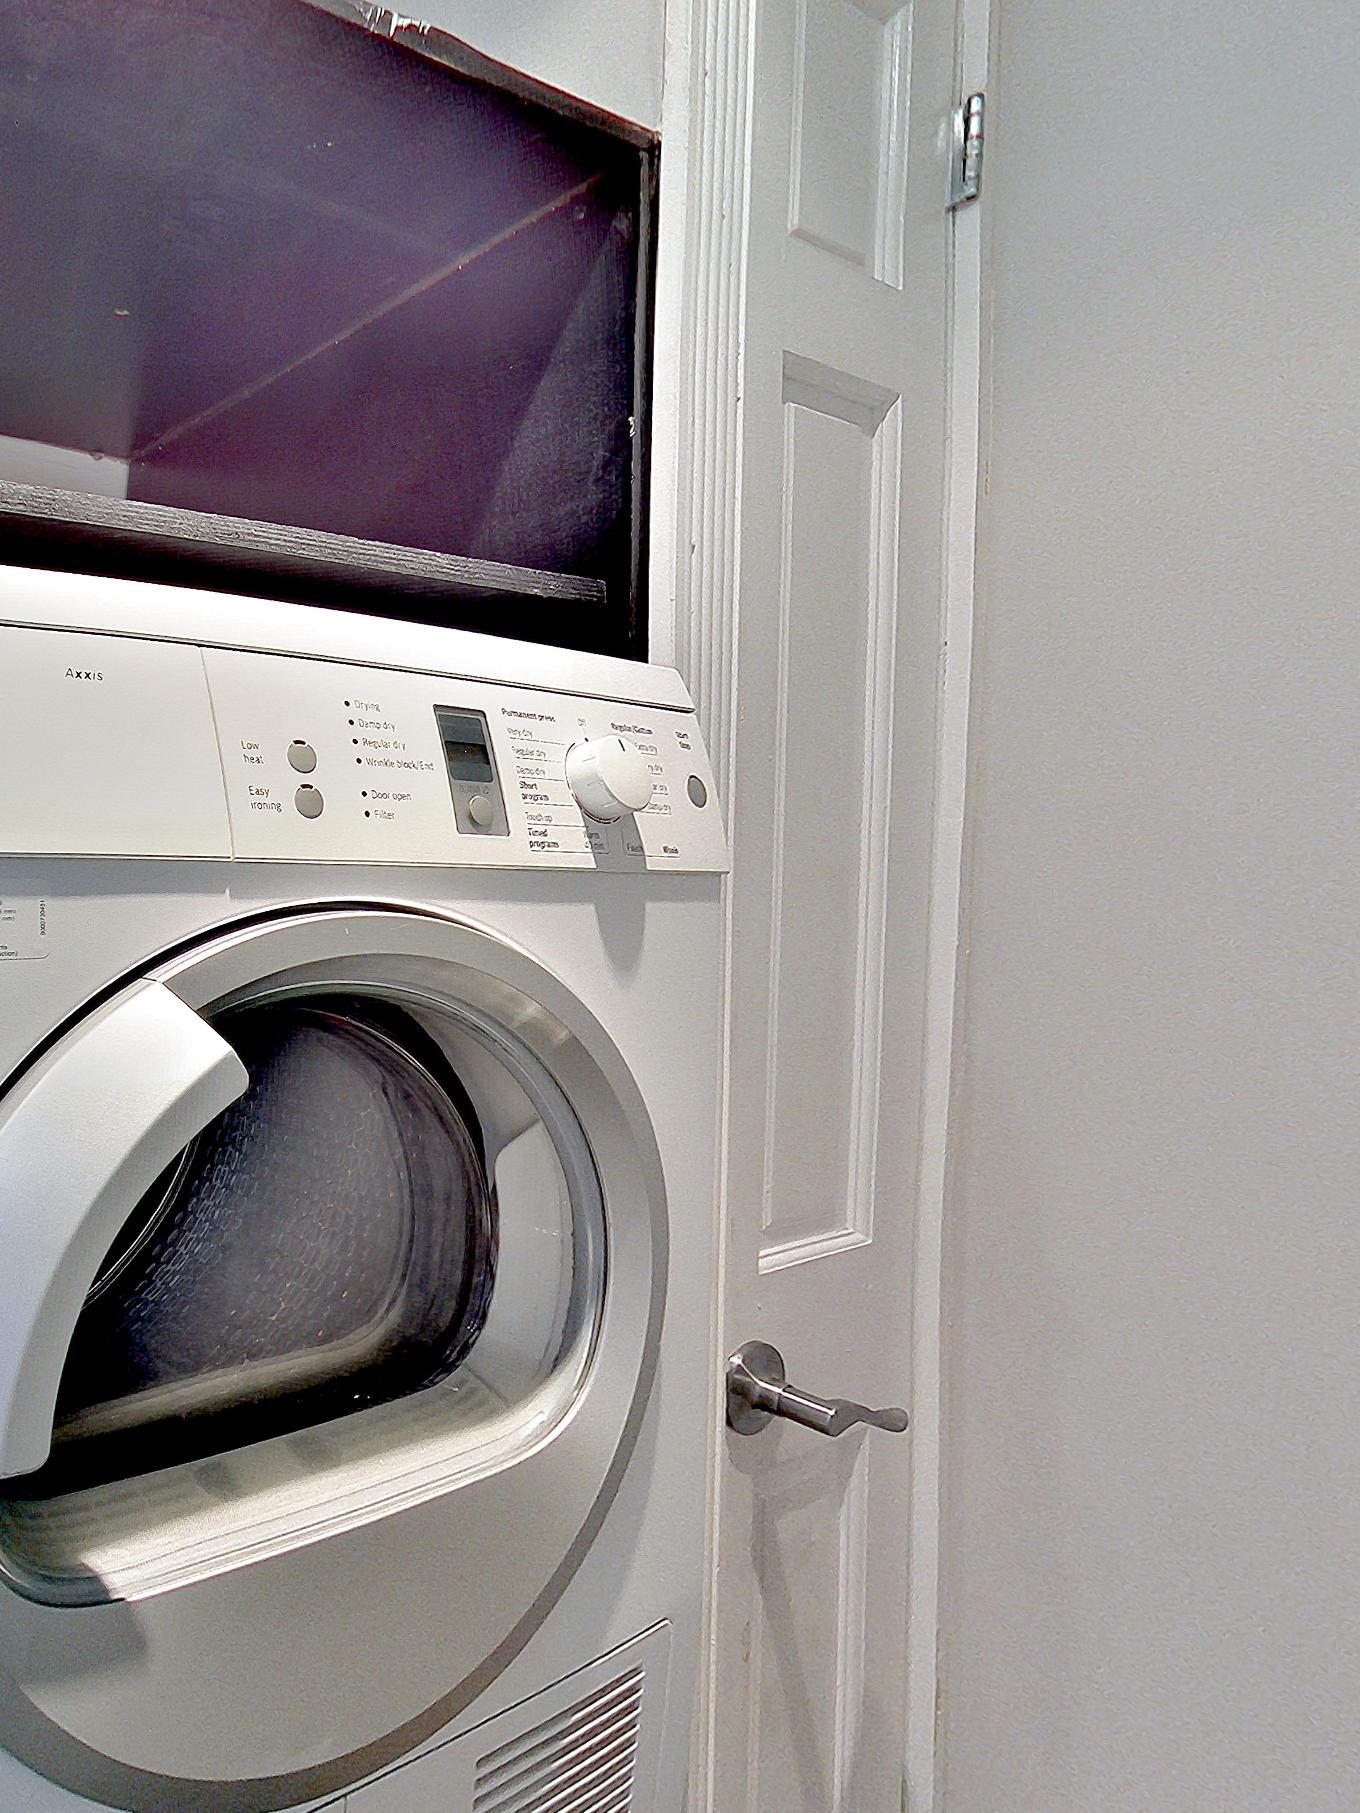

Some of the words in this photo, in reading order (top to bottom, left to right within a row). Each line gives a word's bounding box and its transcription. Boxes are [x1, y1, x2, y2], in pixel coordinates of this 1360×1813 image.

[353, 699, 381, 713] Drying
[357, 718, 382, 730] Damp
[382, 720, 396, 733] dry
[240, 739, 260, 750] Low
[362, 737, 391, 750] Regular
[392, 740, 406, 752] dry
[243, 753, 265, 765] heat
[365, 757, 395, 768] Wrinkle
[248, 785, 270, 798] Easy
[371, 789, 391, 800] Door
[392, 791, 412, 802] open
[250, 801, 283, 813] ironing
[373, 809, 396, 820] Filter
